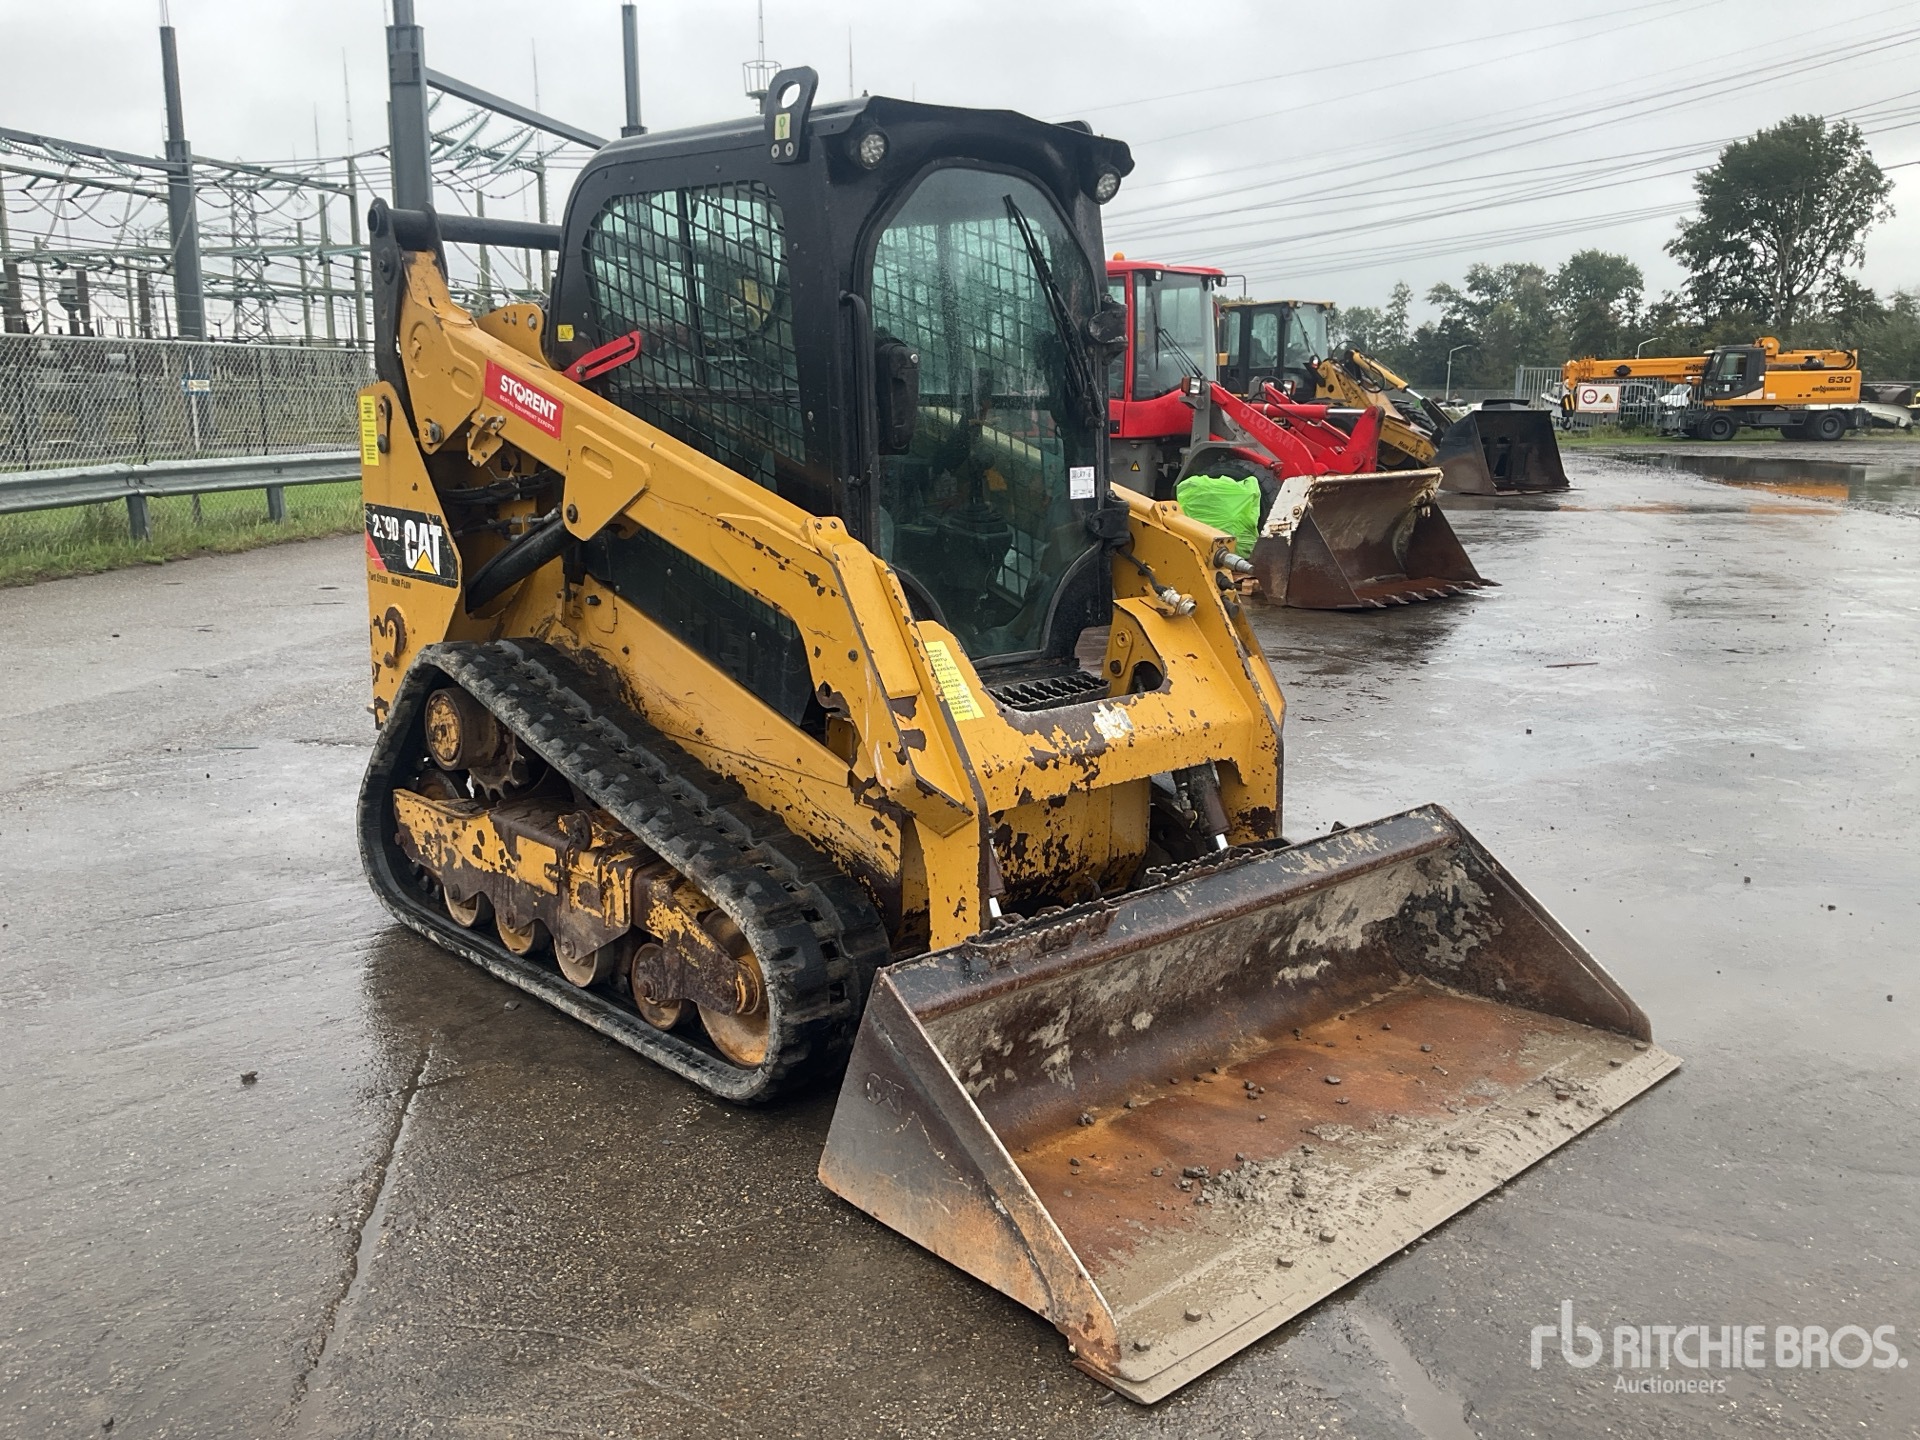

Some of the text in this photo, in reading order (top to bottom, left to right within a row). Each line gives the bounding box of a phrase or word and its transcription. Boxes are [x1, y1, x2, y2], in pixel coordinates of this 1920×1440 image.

[500, 374, 558, 421] STORENT
[1827, 376, 1852, 384] 630
[499, 394, 556, 432] RENTAL EQUIPMENT EXPERTS
[404, 519, 443, 576] CAT
